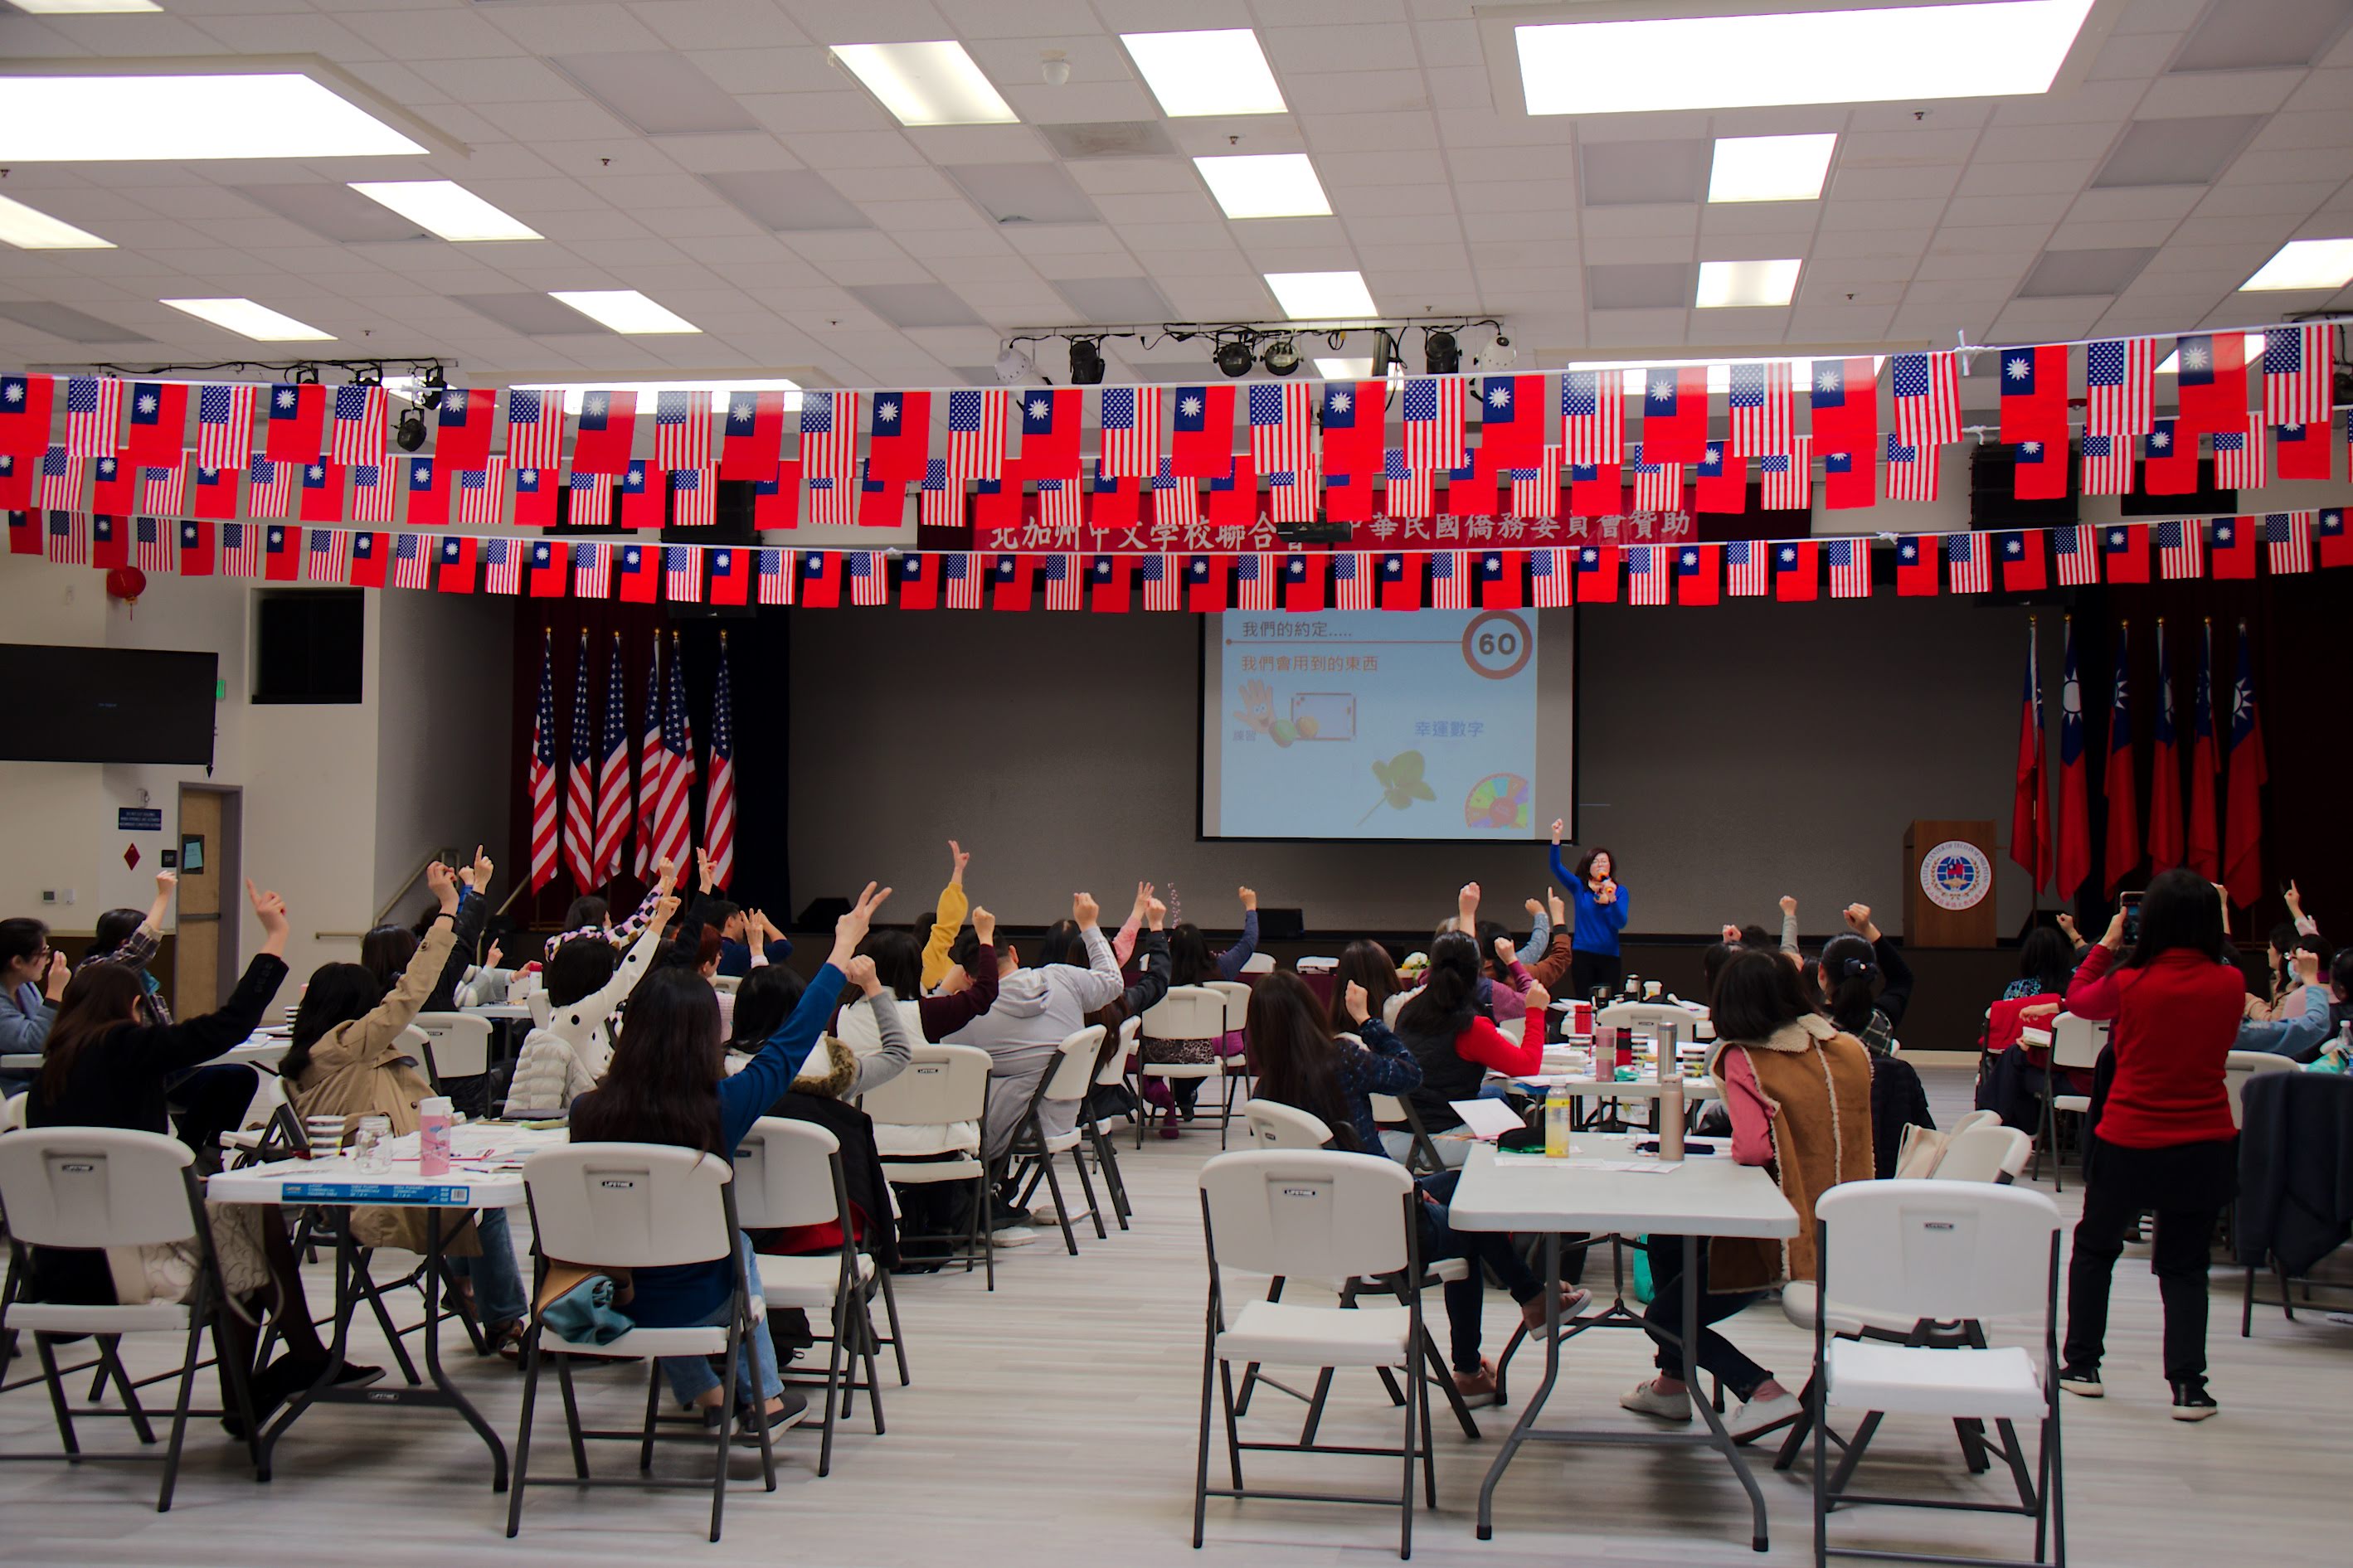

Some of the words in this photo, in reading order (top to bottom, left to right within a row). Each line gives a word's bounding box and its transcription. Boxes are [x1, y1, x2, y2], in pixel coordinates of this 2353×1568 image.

[1479, 633, 1516, 655] 60
[1242, 655, 1378, 672] 我們會用到的東西
[1415, 721, 1484, 737] 幸運數字
